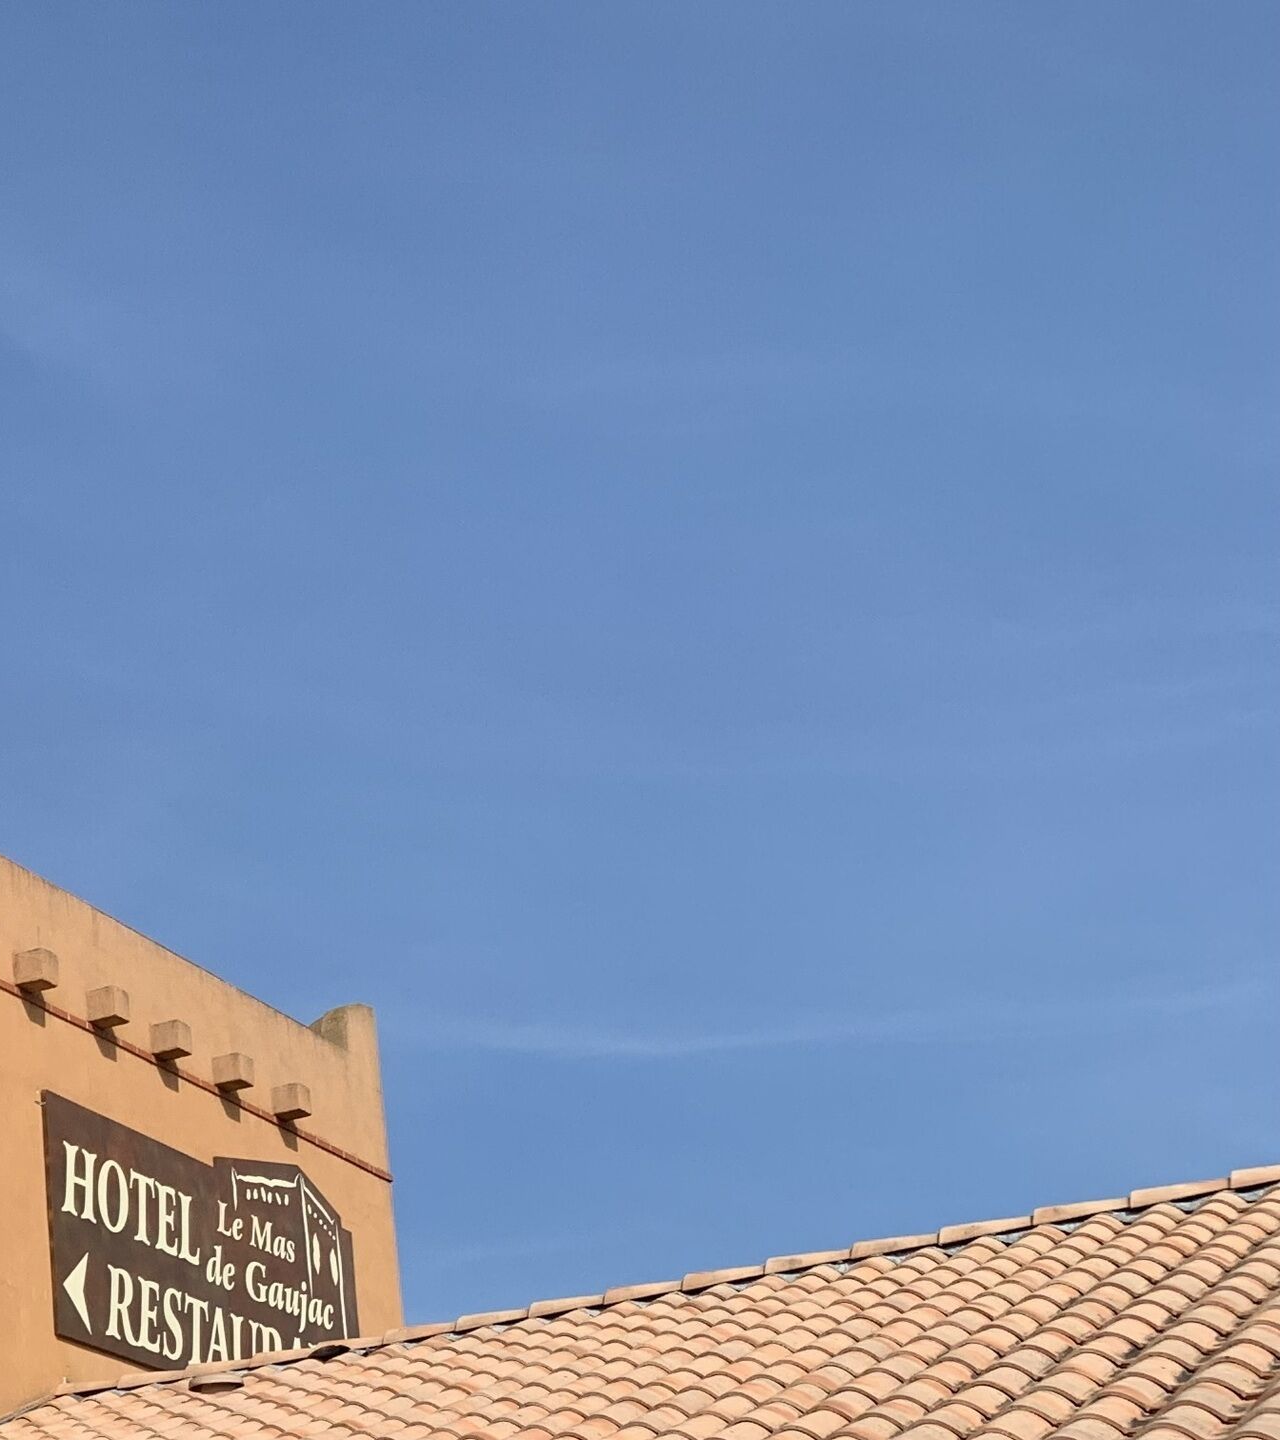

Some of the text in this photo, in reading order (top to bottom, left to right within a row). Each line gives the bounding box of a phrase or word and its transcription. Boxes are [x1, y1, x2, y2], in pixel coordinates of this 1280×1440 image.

[61, 1140, 200, 1266] HOTEL
[217, 1200, 296, 1263] Le Mas
[206, 1245, 334, 1333] de Gaujac
